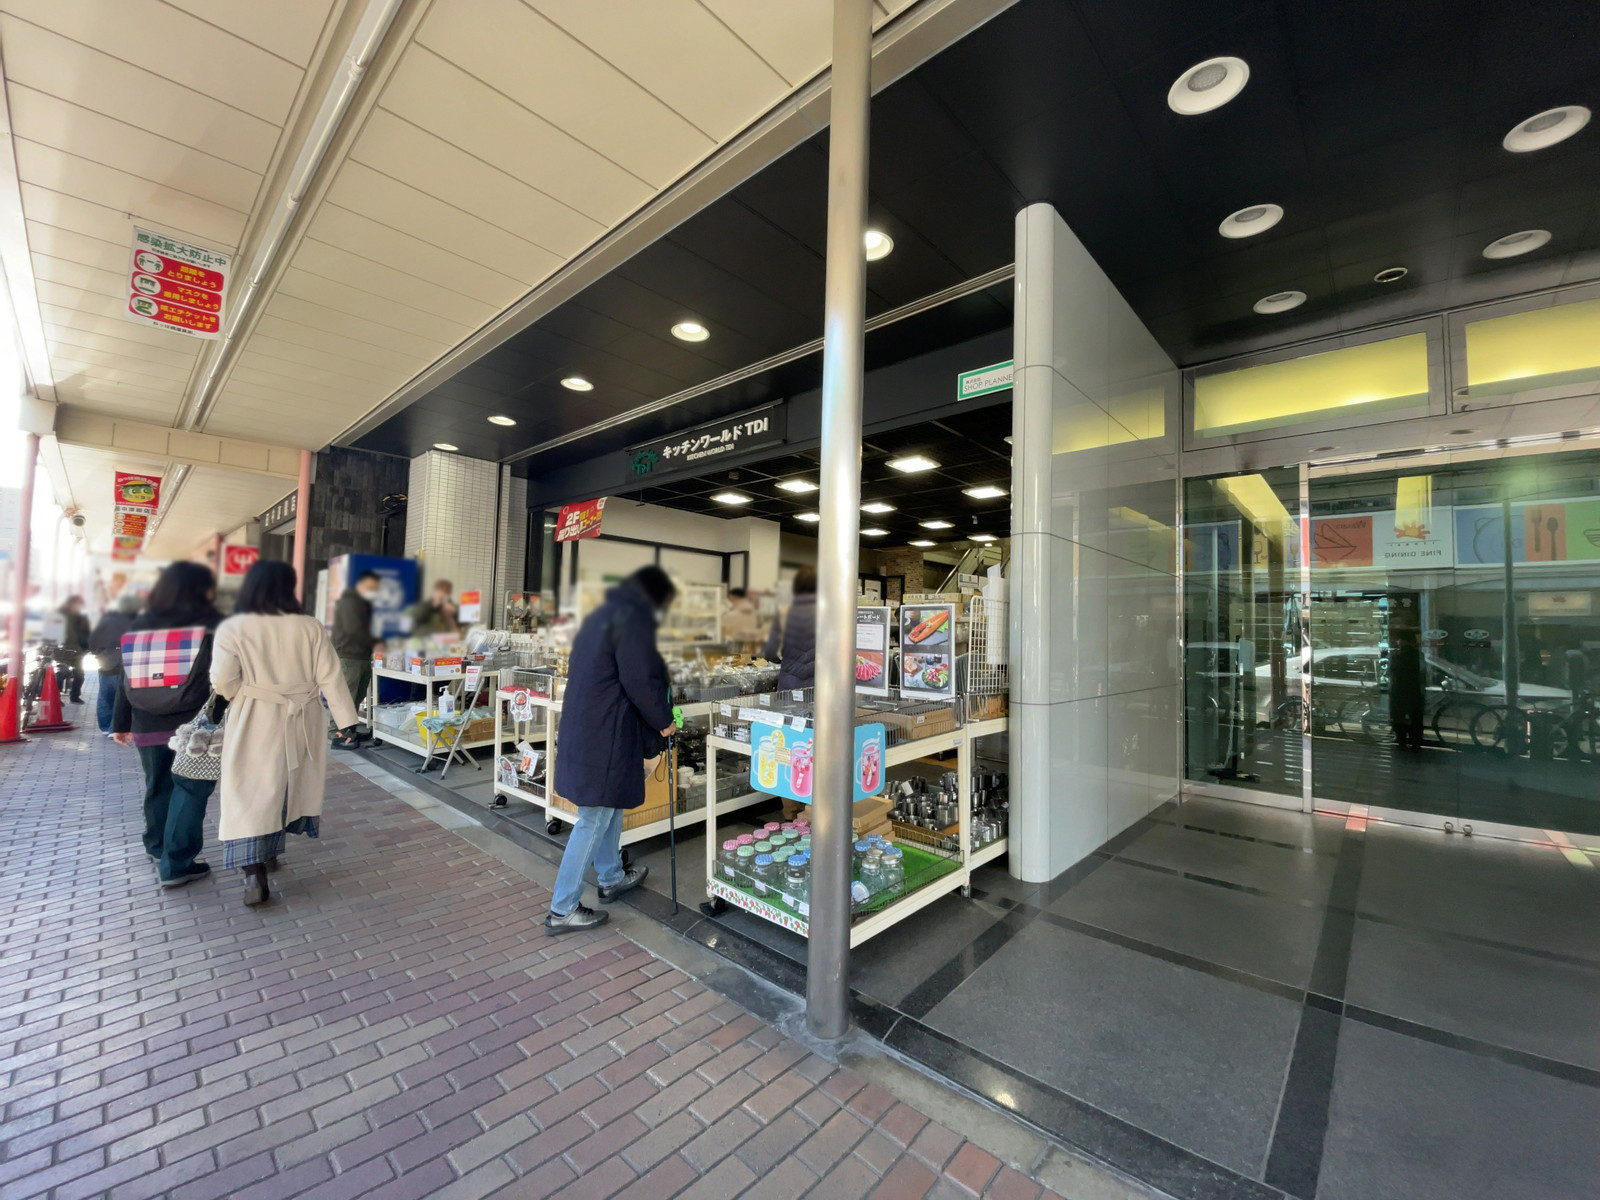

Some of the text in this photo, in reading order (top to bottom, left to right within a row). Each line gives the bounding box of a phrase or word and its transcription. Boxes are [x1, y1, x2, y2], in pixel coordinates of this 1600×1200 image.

[136, 232, 226, 267] 感染拡大防止中
[167, 269, 216, 288] とりましょう
[163, 290, 218, 310] 着用しましょう
[176, 286, 208, 300] マスクを
[159, 304, 216, 323] 咳エチケットを
[163, 313, 212, 330] お願いします
[964, 374, 1013, 392] SHOP PLANNE
[663, 424, 743, 459] キッチンワールド
[745, 417, 769, 436] TDI
